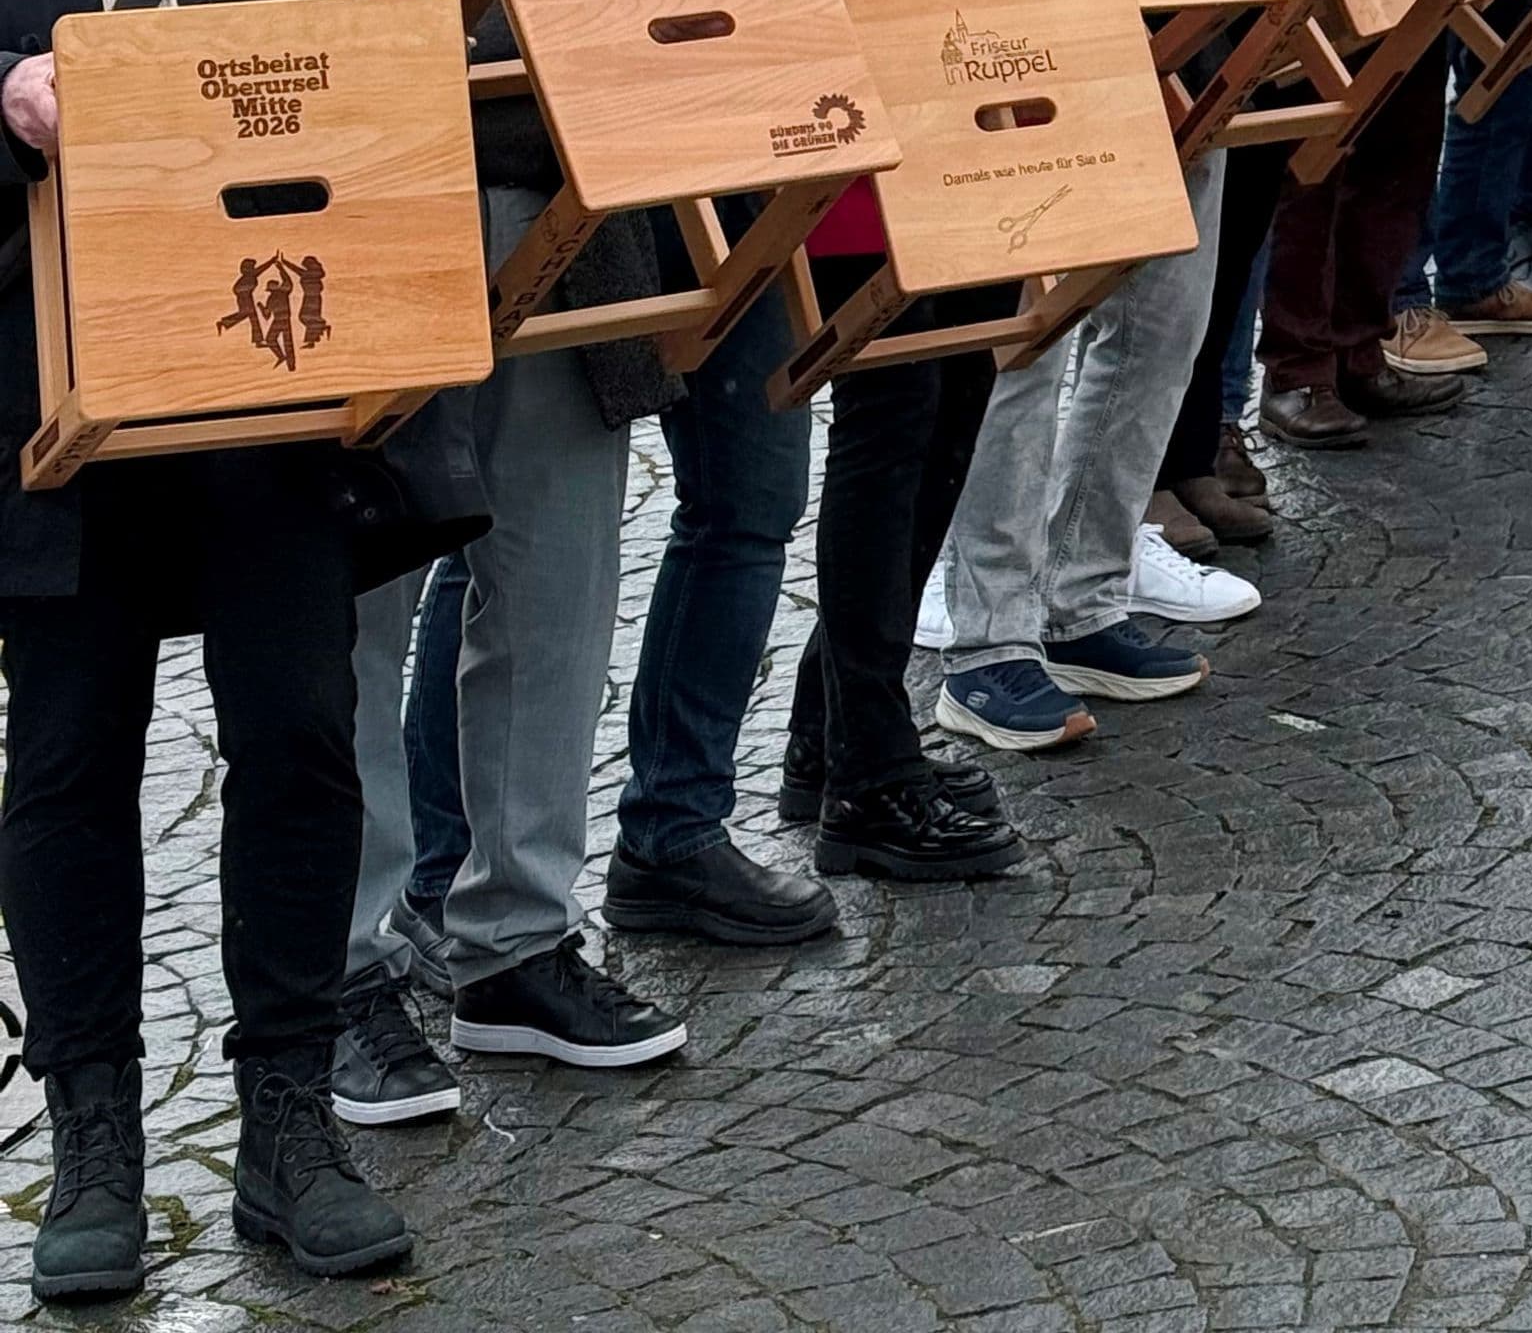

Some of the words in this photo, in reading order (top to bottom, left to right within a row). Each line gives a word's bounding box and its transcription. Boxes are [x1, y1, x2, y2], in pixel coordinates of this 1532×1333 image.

[197, 52, 330, 79] Ortsbeirat
[200, 69, 329, 100] Oberursel
[231, 96, 303, 119] Mitte
[237, 114, 301, 139] 2026
[772, 138, 790, 151] DIE
[793, 132, 836, 148] GRÜNEN
[943, 168, 991, 187] Damals
[993, 165, 1017, 179] wie
[1018, 161, 1055, 176] heute
[1056, 156, 1074, 170] für
[1075, 153, 1098, 168] Sie
[1099, 150, 1117, 164] da
